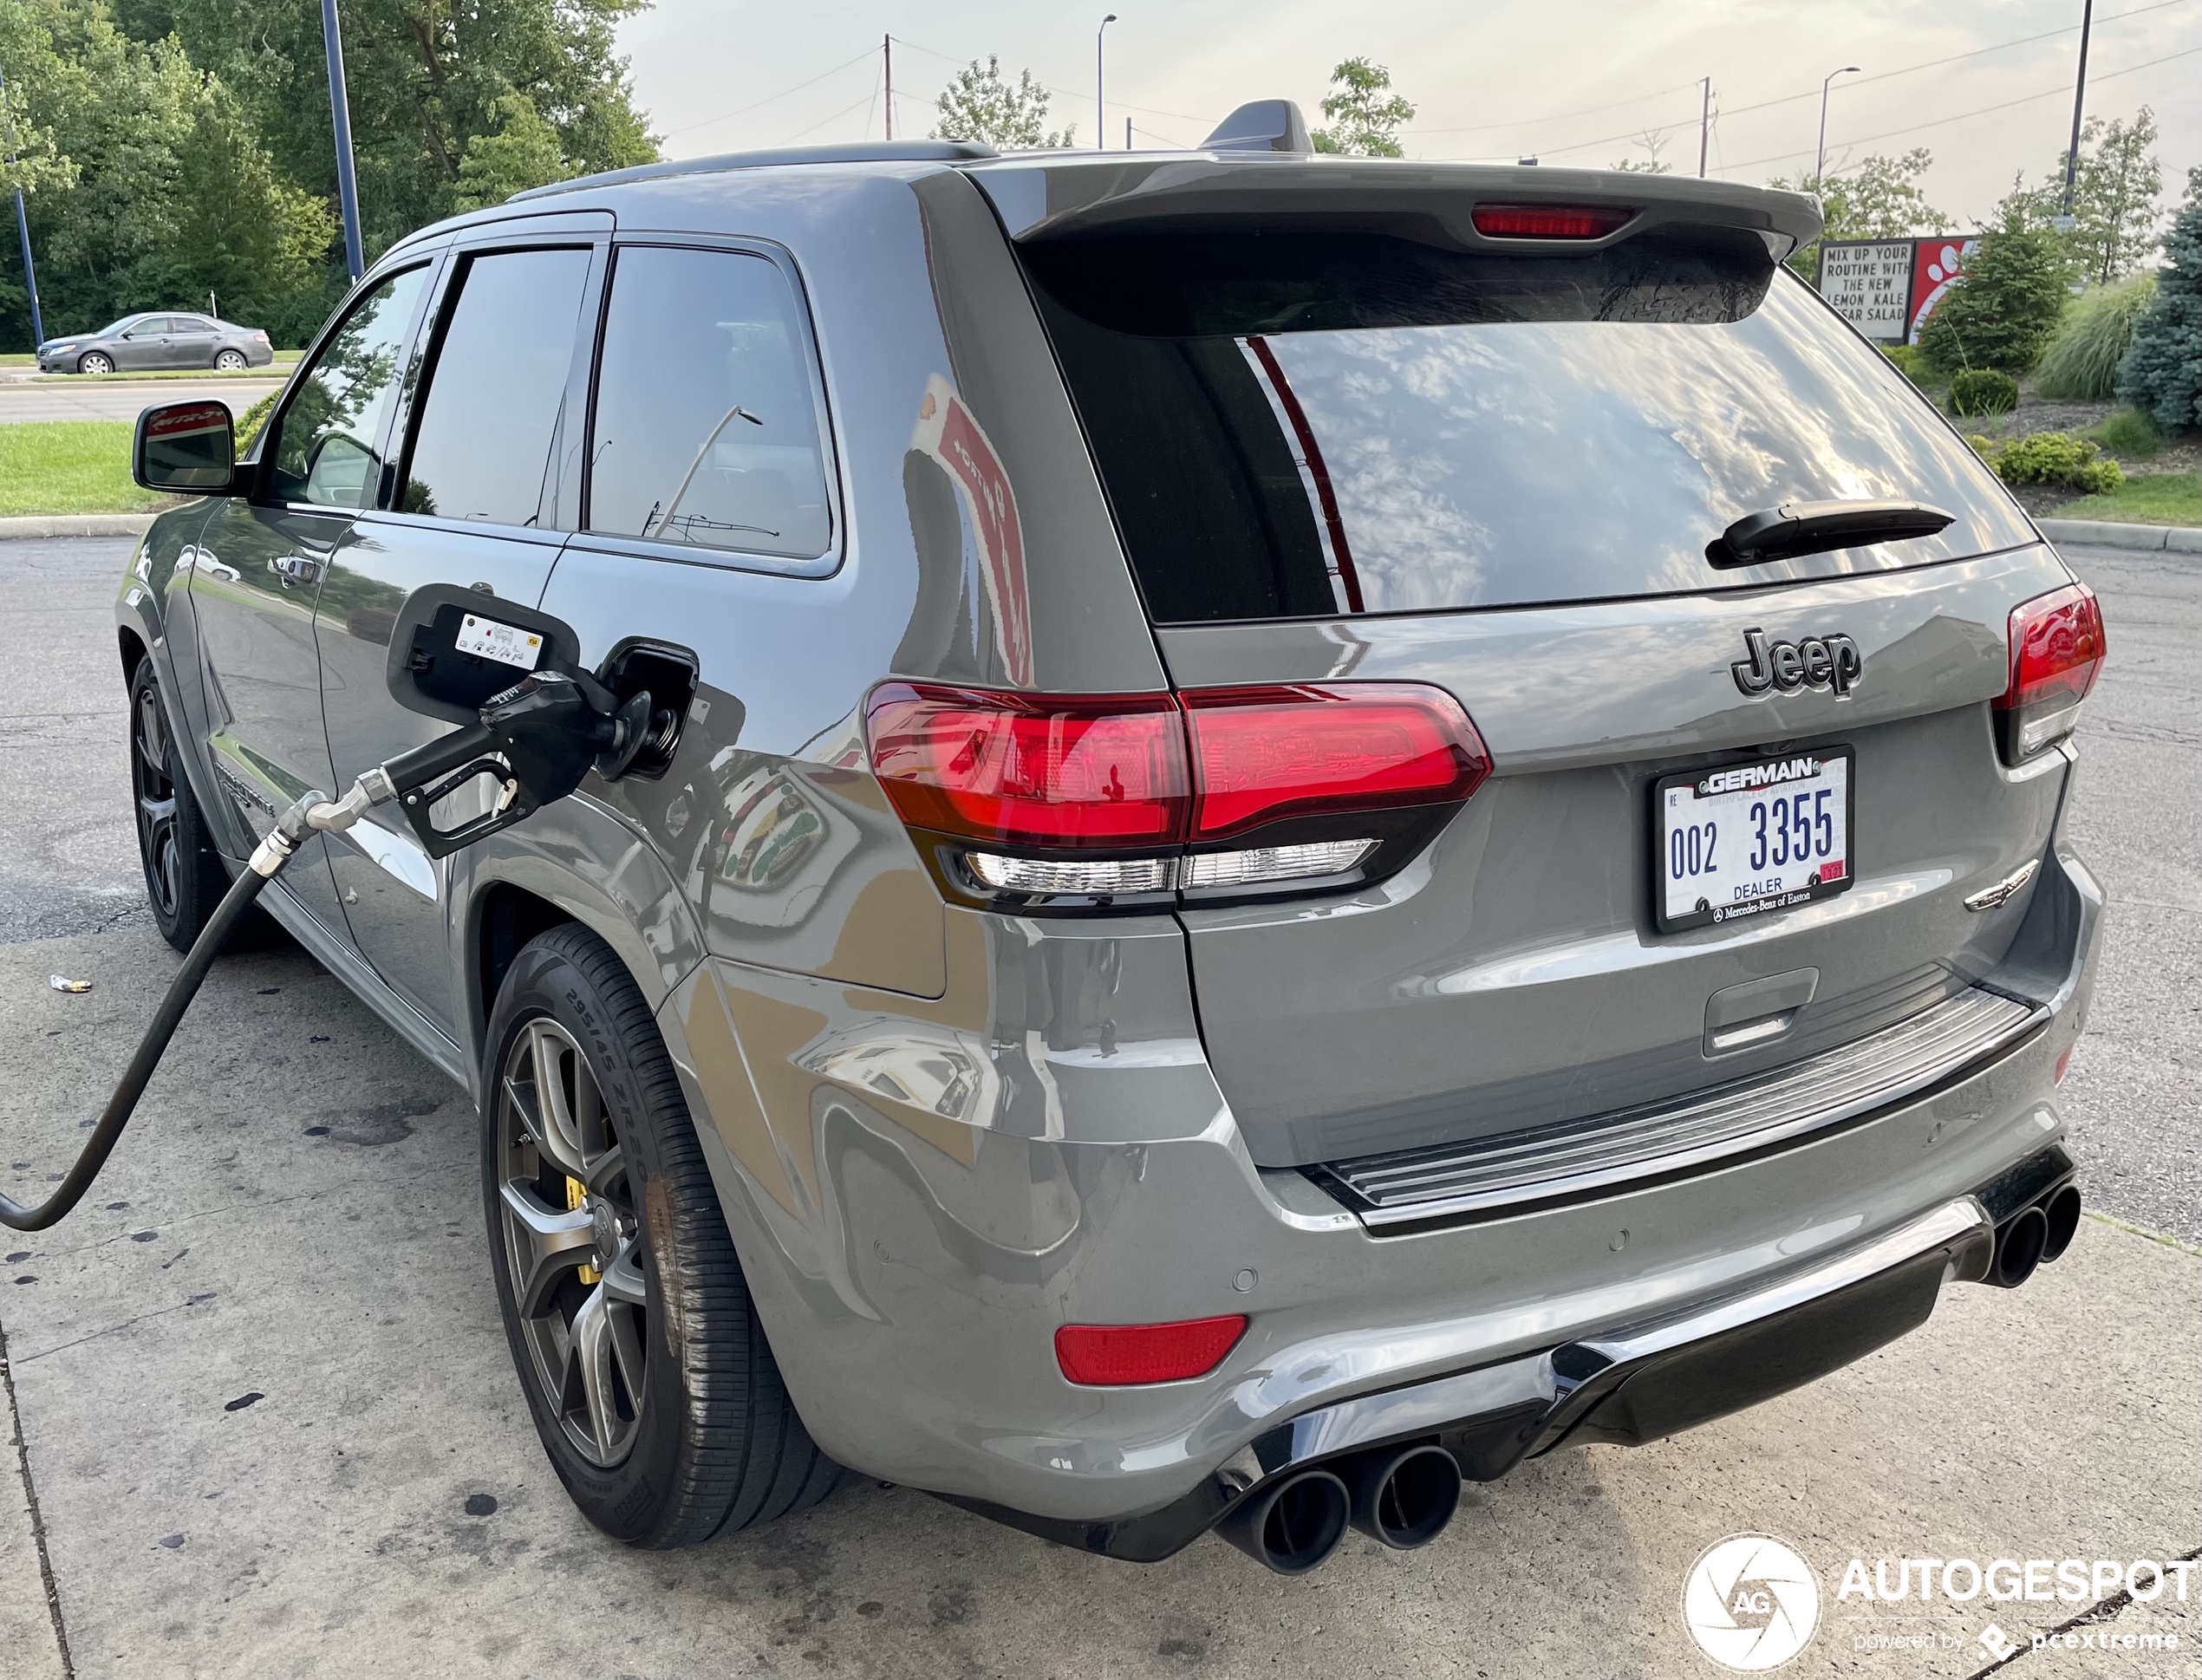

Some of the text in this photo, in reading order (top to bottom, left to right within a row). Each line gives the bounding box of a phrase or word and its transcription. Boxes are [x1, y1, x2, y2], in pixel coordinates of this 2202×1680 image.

[1827, 246, 1908, 263] MIX UP YOUR
[1827, 262, 1911, 277] ROUTINE WITH
[1843, 277, 1893, 291] THE NEW
[1827, 293, 1905, 307] LEMON KALE
[1866, 308, 1905, 321] SALAD
[1730, 627, 1862, 702] Jeep
[1707, 757, 1813, 794] GERMAIN
[1671, 788, 1833, 880] 002 3355
[1734, 876, 1782, 901] DEALER
[1724, 890, 1811, 920] Mercedes-Benz of Easton
[565, 987, 616, 1073] 295/45
